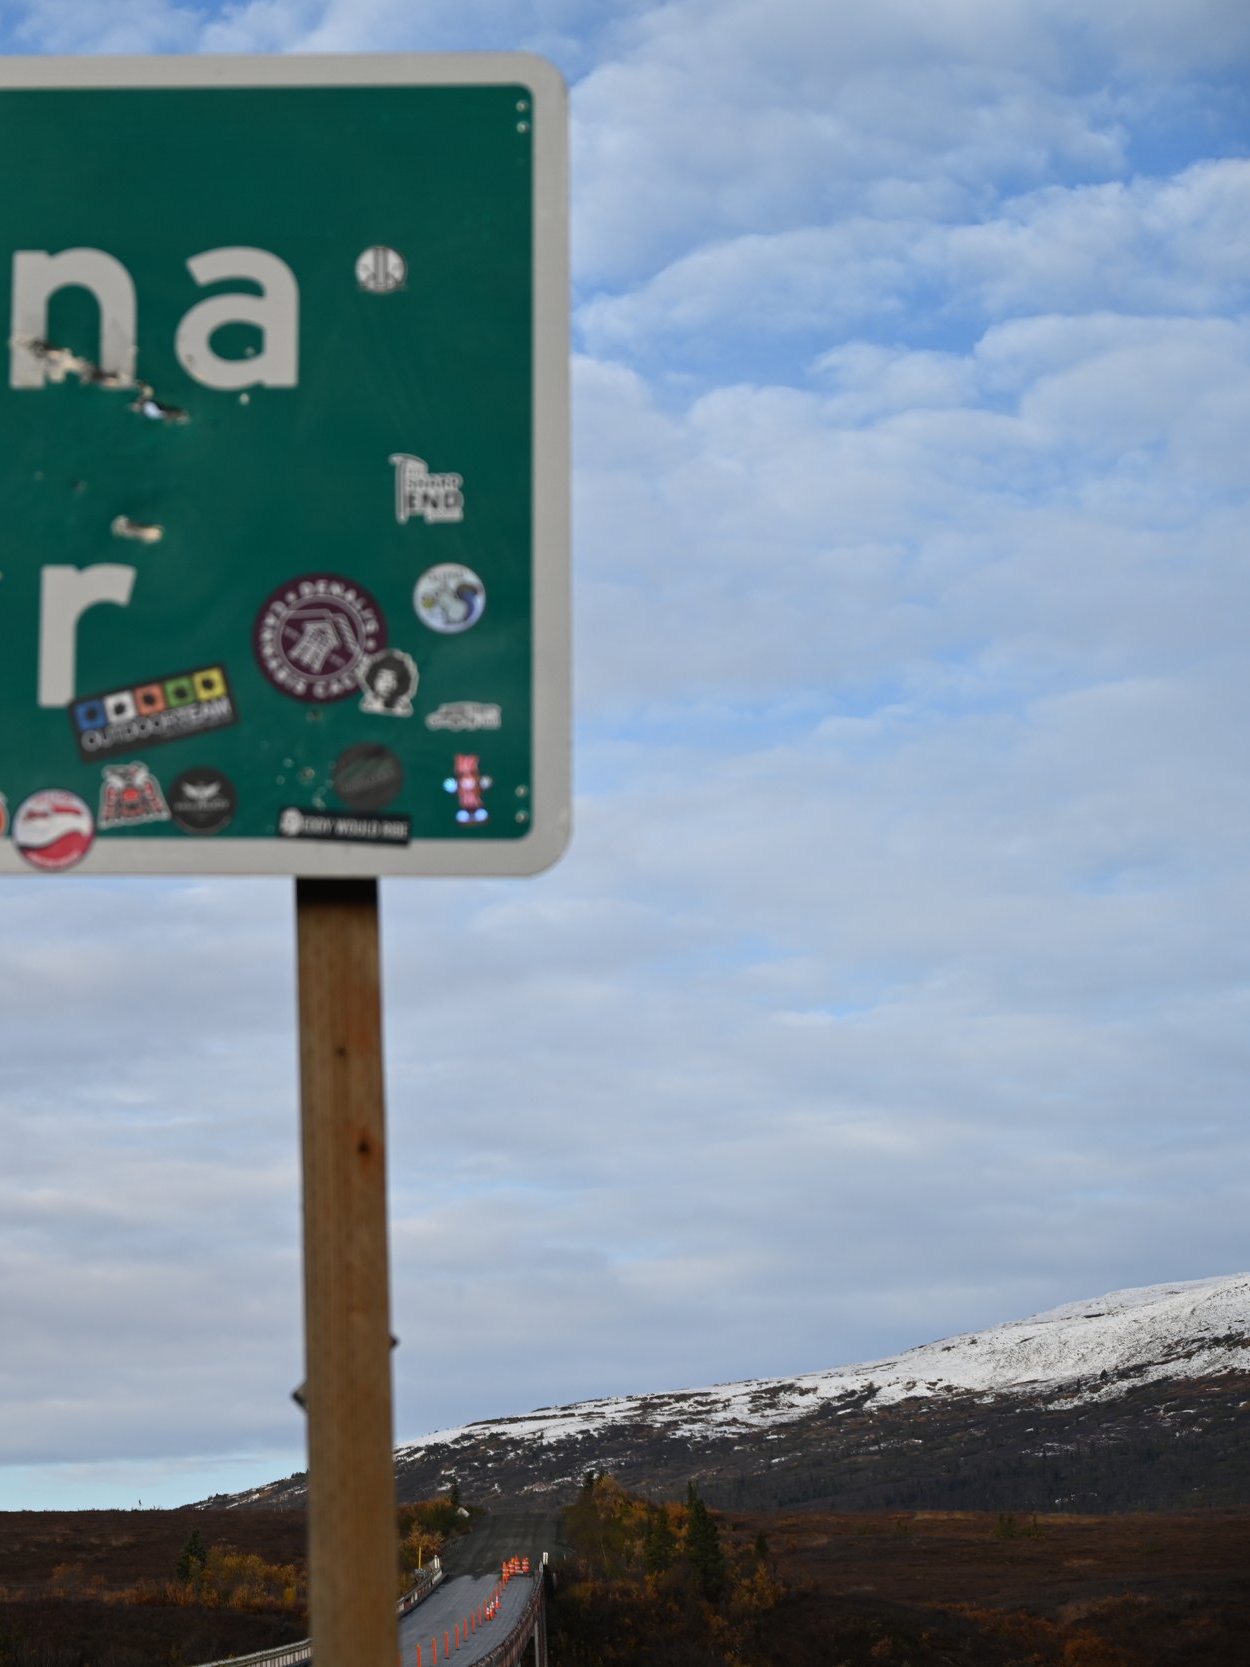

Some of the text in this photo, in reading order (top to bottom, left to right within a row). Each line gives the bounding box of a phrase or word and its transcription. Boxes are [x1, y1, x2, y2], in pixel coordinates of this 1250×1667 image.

[406, 492, 461, 510] END
[335, 817, 379, 836] WOULD
[381, 819, 410, 838] RIDE
